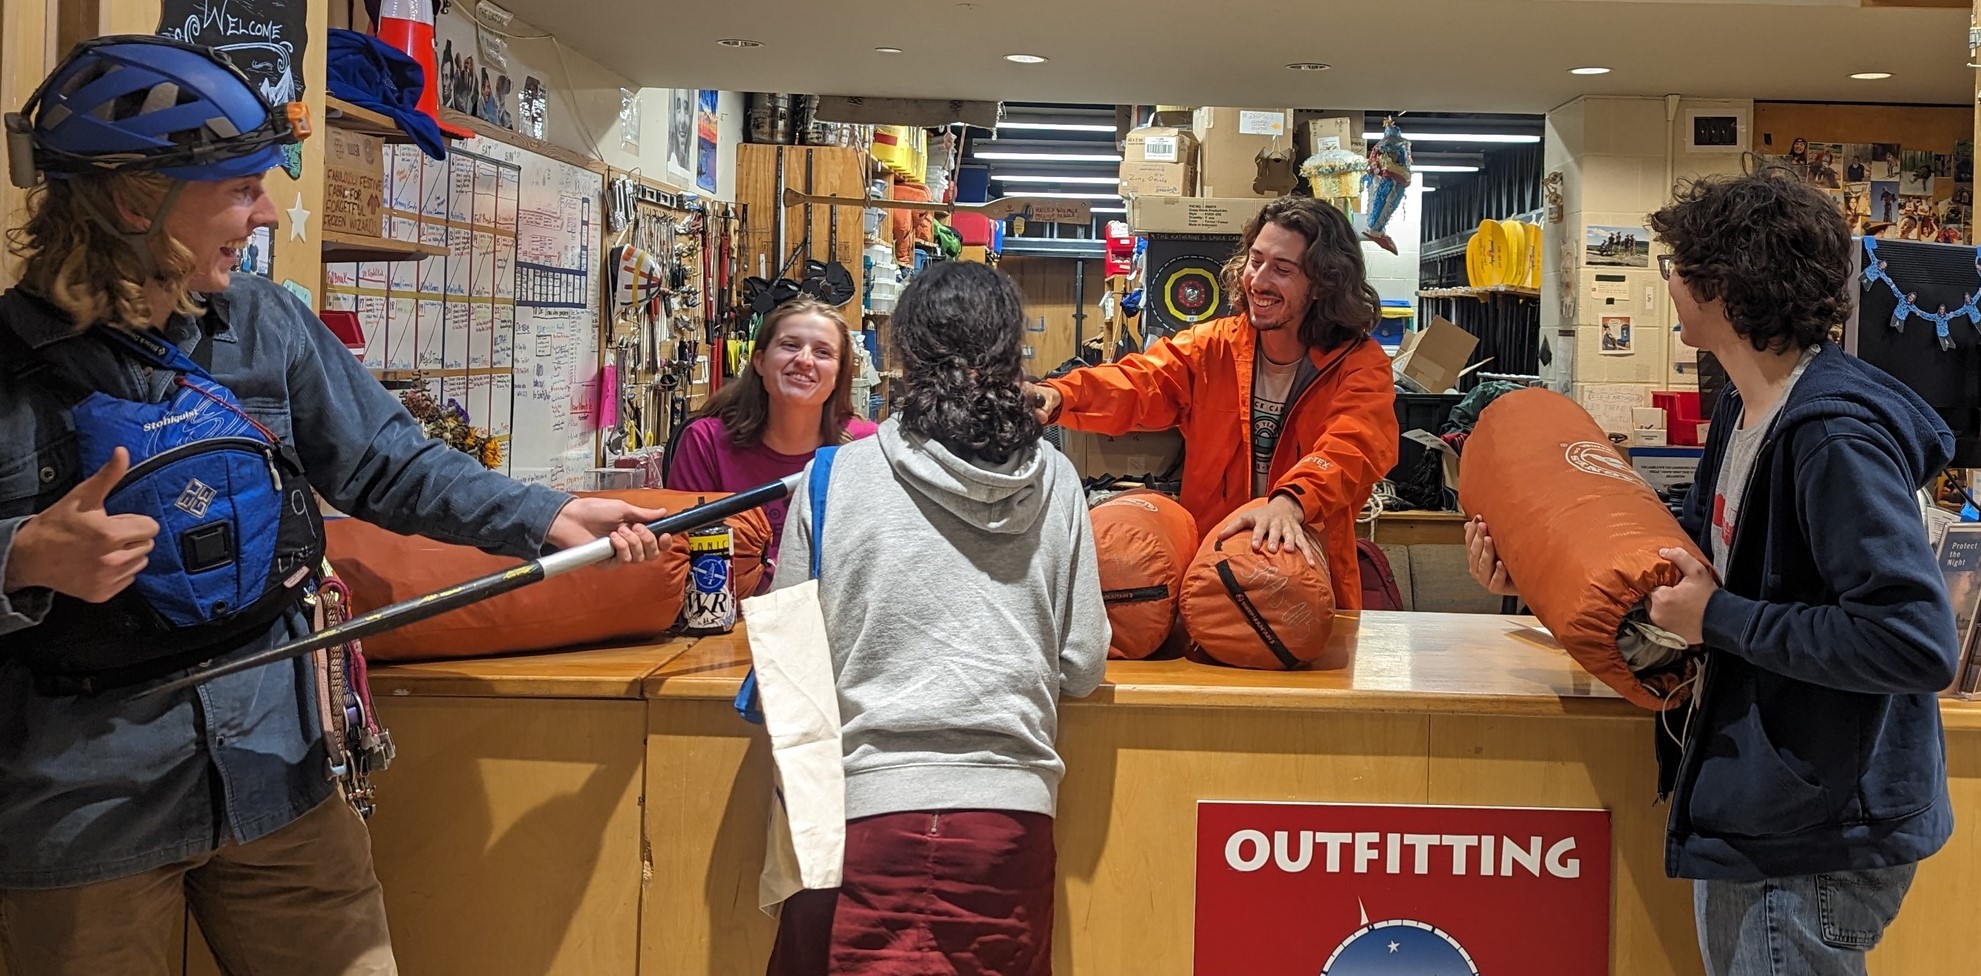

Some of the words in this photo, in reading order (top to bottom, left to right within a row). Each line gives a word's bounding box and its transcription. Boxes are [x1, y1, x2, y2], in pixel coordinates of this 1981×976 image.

[143, 409, 198, 432] Stohlquist
[1951, 542, 1978, 550] Protect
[1946, 559, 1966, 568] Night
[1224, 828, 1581, 880] OUTFITTING
